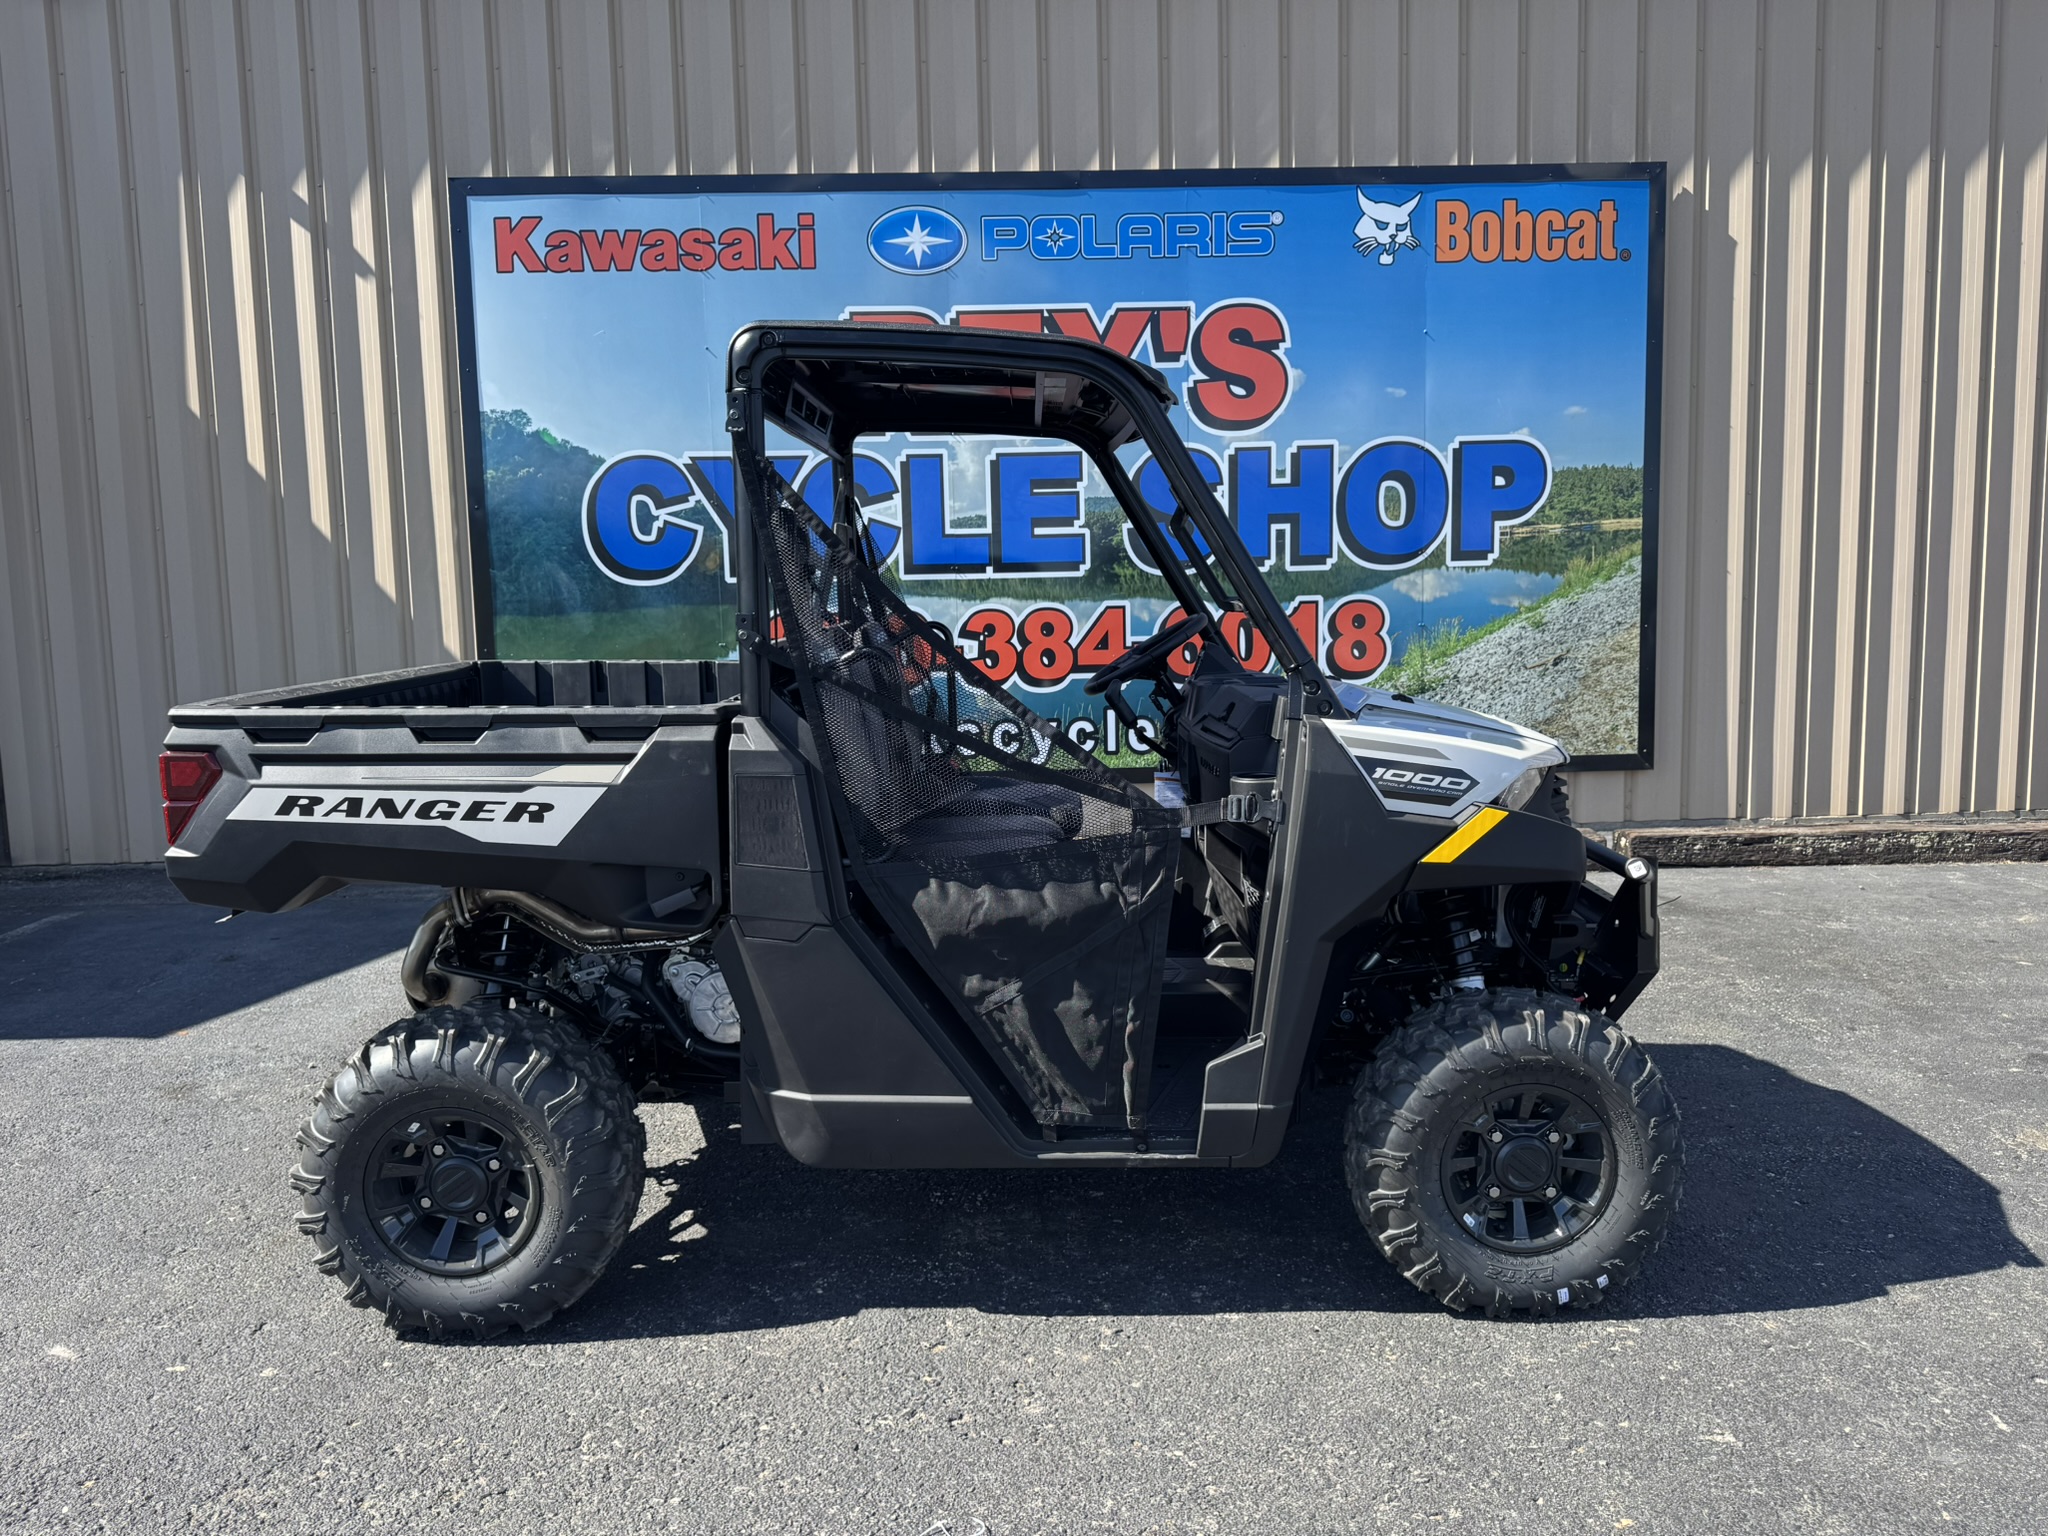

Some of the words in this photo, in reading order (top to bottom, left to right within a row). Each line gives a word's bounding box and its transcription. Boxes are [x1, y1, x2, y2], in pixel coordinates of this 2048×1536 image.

[493, 213, 816, 273] Kawasaki
[981, 210, 1276, 261] POLARIS
[1434, 198, 1618, 263] Bobcat
[1371, 766, 1471, 790] 1000
[274, 794, 556, 825] RANGER
